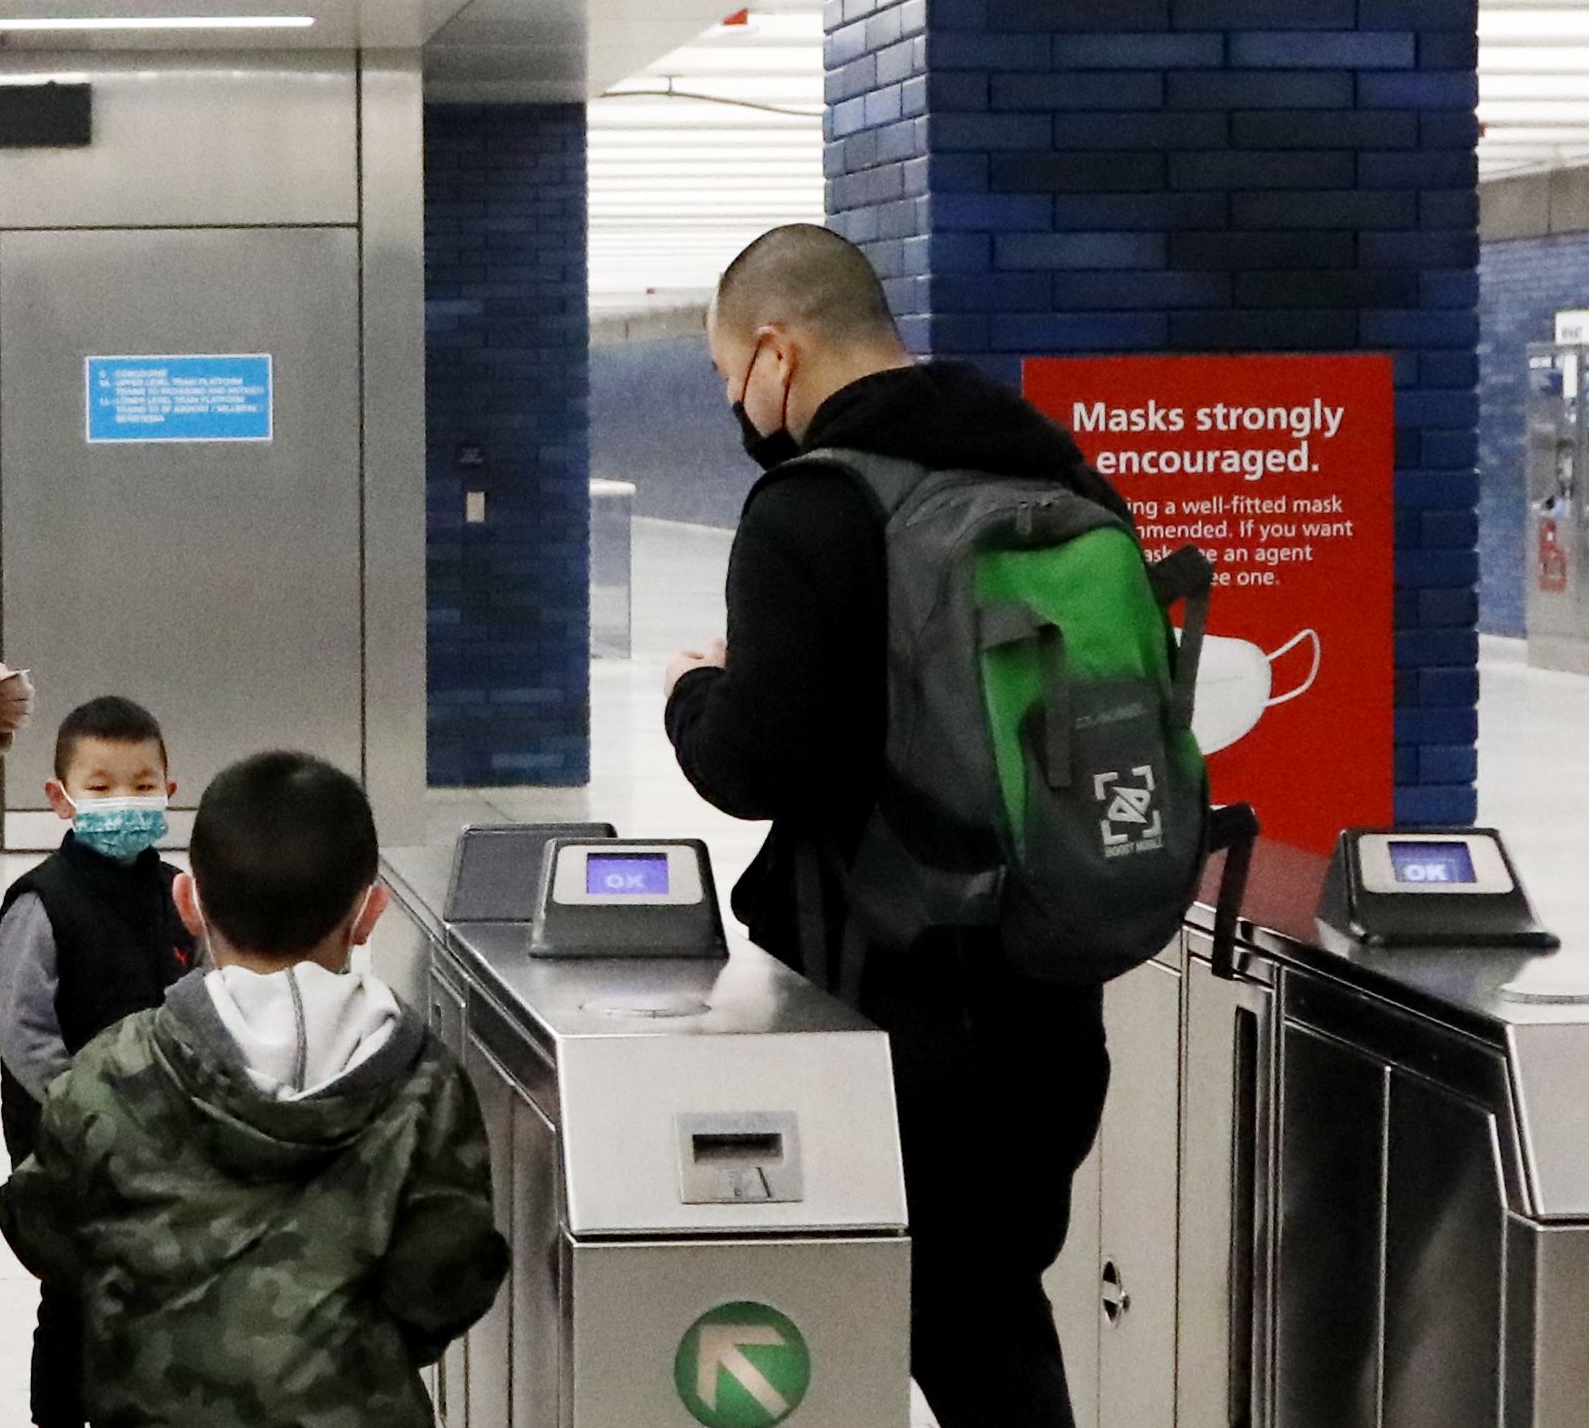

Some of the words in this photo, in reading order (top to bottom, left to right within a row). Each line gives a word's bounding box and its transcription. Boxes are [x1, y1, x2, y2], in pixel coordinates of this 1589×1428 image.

[1072, 400, 1185, 432] Masks
[1195, 398, 1345, 438] strongly
[1096, 441, 1320, 481] encouraged.
[1164, 501, 1176, 515] a
[1182, 494, 1287, 514] well-fitted
[1292, 494, 1343, 513] mask
[1240, 519, 1254, 538] If
[1259, 523, 1296, 542] you
[1302, 520, 1353, 537] want
[1223, 548, 1249, 562] an
[1255, 544, 1313, 566] agent
[1236, 572, 1280, 586] one.
[1404, 864, 1449, 881] OK
